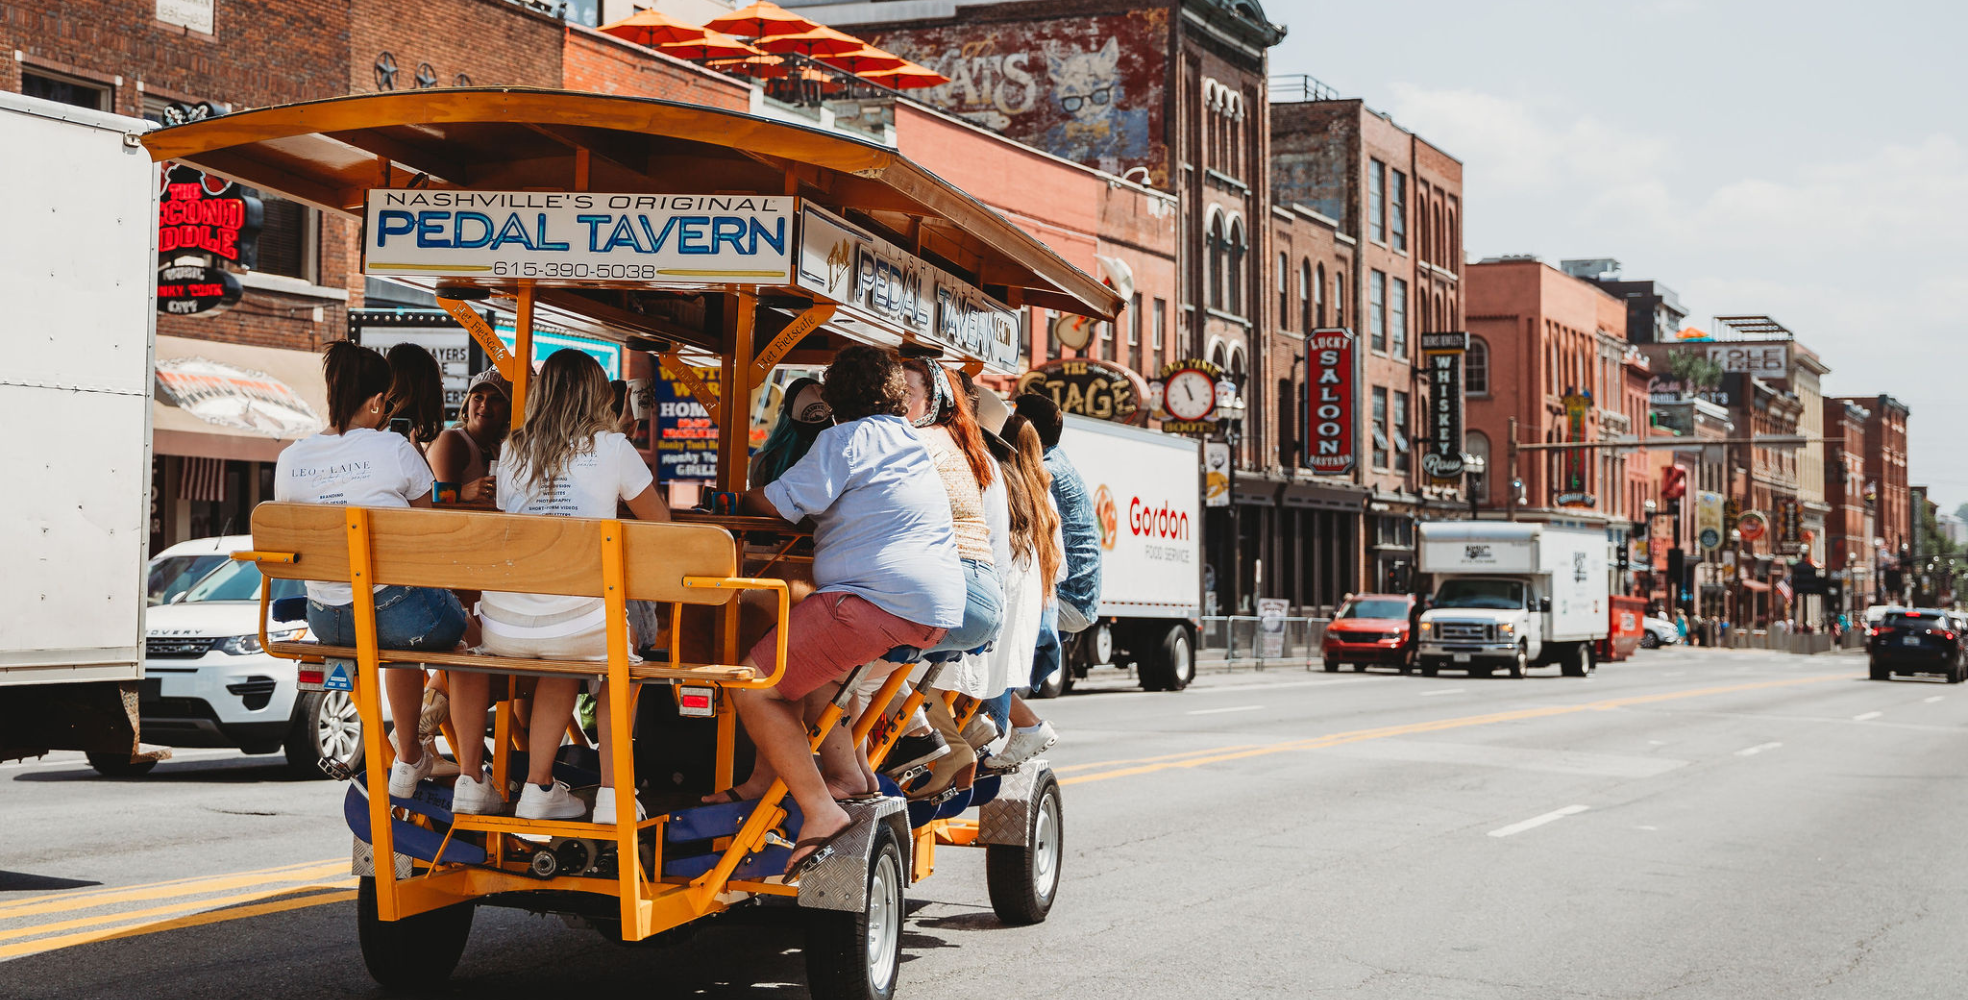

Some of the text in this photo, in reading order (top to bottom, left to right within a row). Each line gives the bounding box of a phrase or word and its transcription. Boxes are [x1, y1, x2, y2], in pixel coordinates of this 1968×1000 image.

[168, 182, 203, 200] THE
[386, 192, 778, 212] NASHVILLE'S ORIGINAL
[158, 225, 239, 260] DDLE
[377, 209, 785, 256] PEDAL TAVERN
[493, 261, 655, 278] 615-390-5038
[857, 244, 928, 326] PEDAL
[938, 282, 995, 361] TAVERN
[452, 303, 473, 324] Het
[1310, 336, 1350, 350] LUCKY
[757, 350, 777, 372] Het
[1063, 362, 1088, 375] THE
[1018, 371, 1136, 419] STAGE
[1317, 351, 1341, 455] SALOON
[1435, 356, 1452, 455] WHISKEY
[1164, 421, 1216, 434] BOOTS
[292, 461, 371, 477] LEO LAINE
[1130, 496, 1189, 541] Gordon
